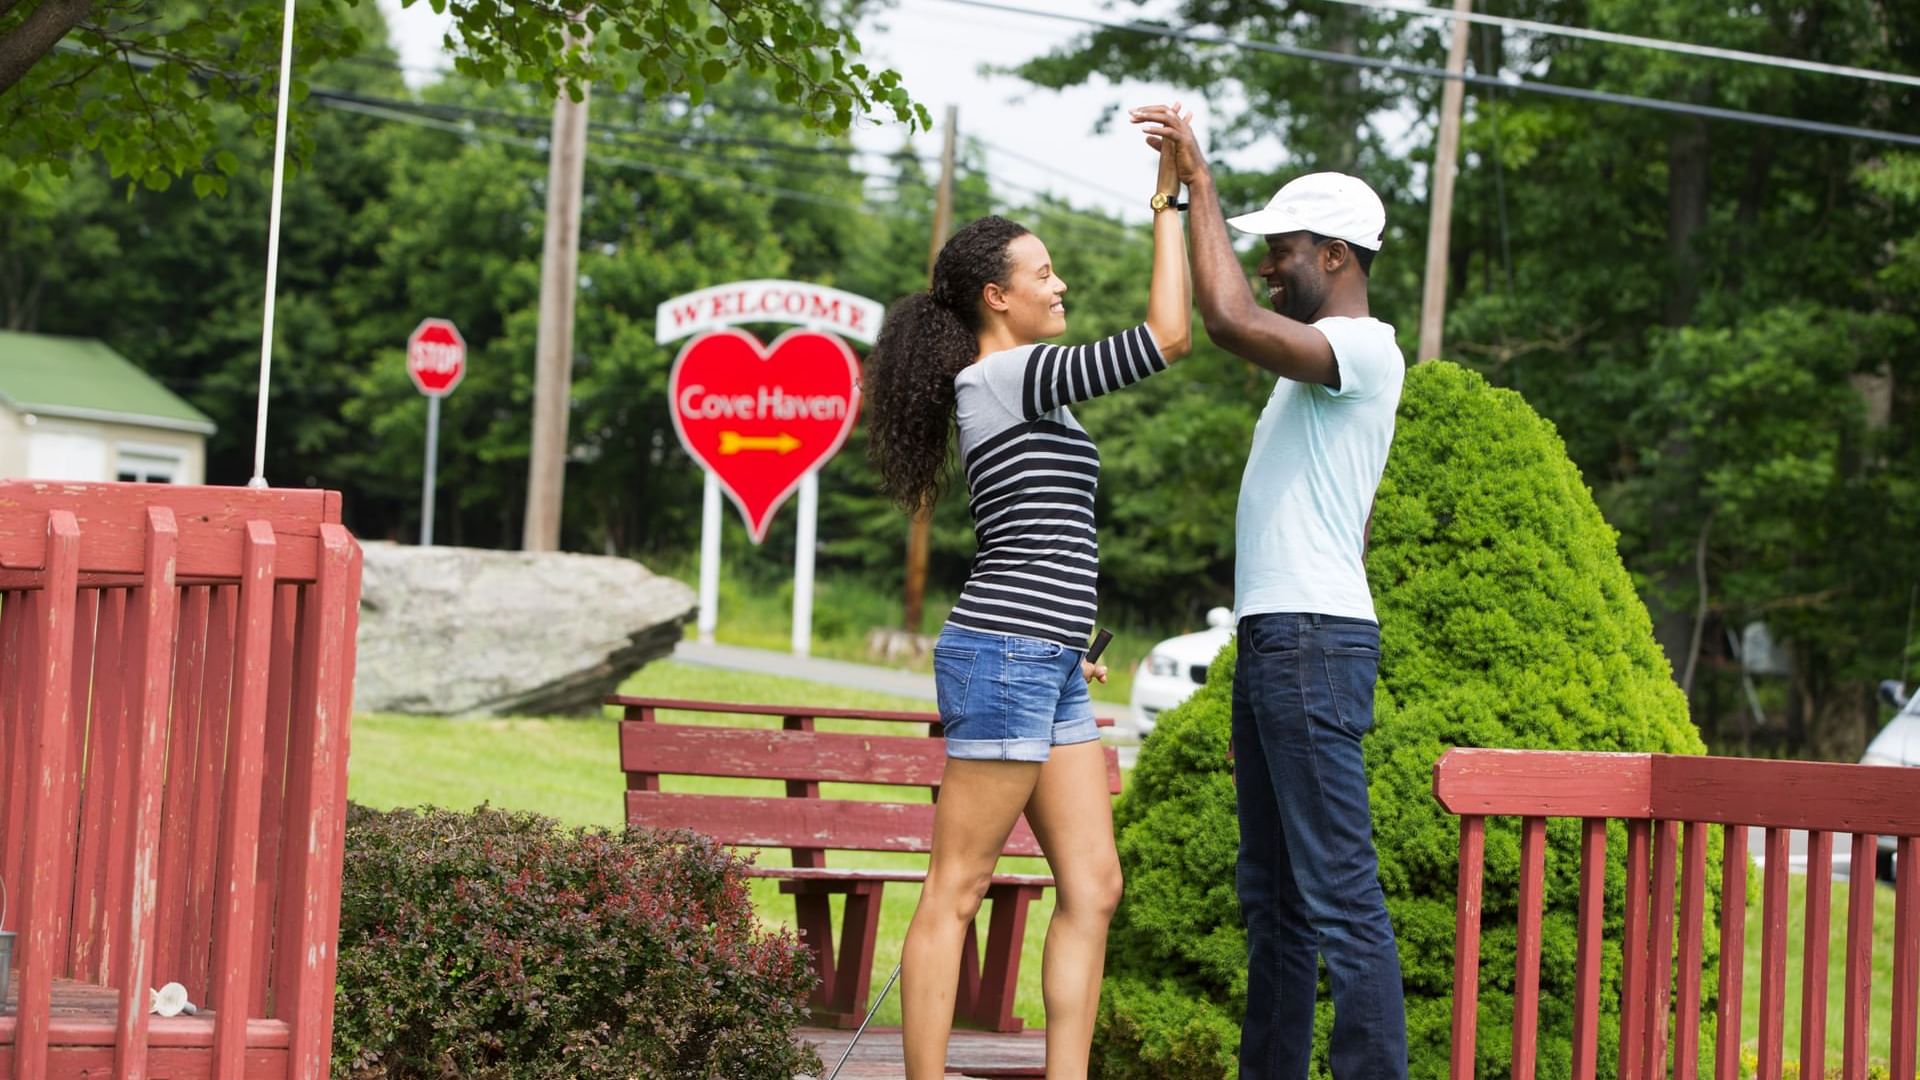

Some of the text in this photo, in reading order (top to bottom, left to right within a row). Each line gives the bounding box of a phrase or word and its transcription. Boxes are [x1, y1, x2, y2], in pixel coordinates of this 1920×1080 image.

[671, 290, 868, 334] WELCOME
[411, 340, 461, 374] STOP
[679, 384, 847, 421] Cove Haven
